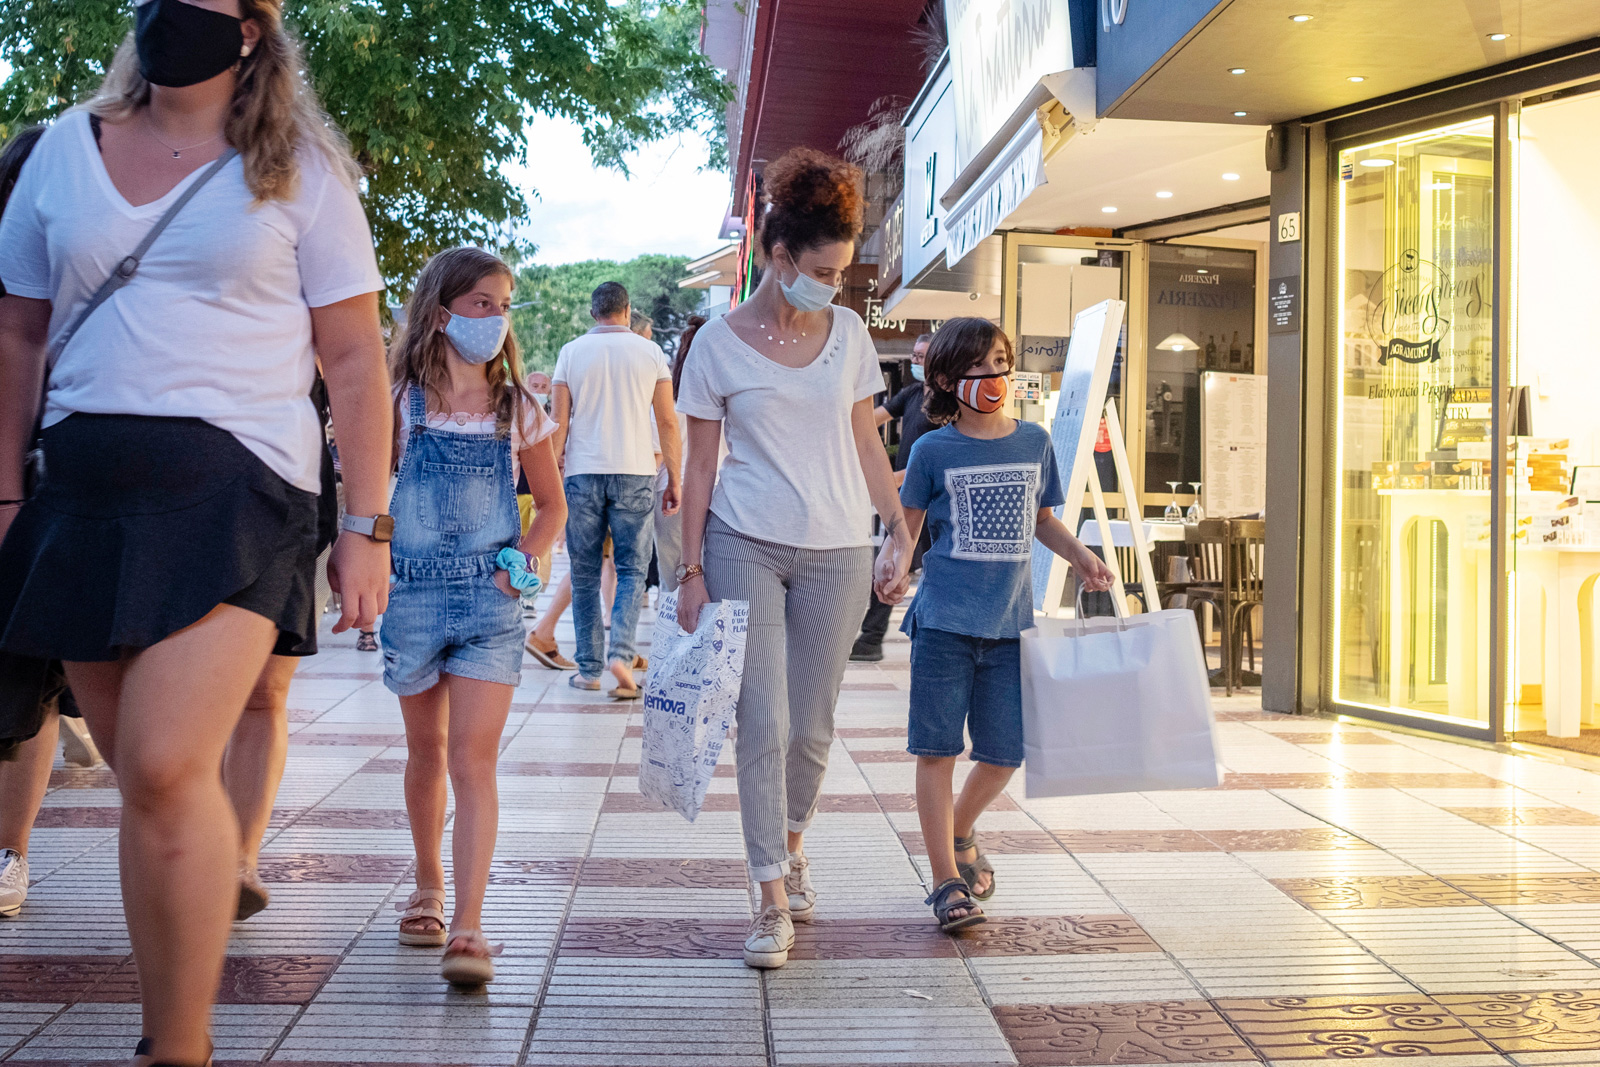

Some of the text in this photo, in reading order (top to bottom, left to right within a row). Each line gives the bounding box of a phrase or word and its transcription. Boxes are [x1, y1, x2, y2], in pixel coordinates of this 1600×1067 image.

[1281, 216, 1295, 240] 65
[1389, 343, 1430, 359] AGRAMUNT
[1368, 381, 1419, 399] Elaboració
